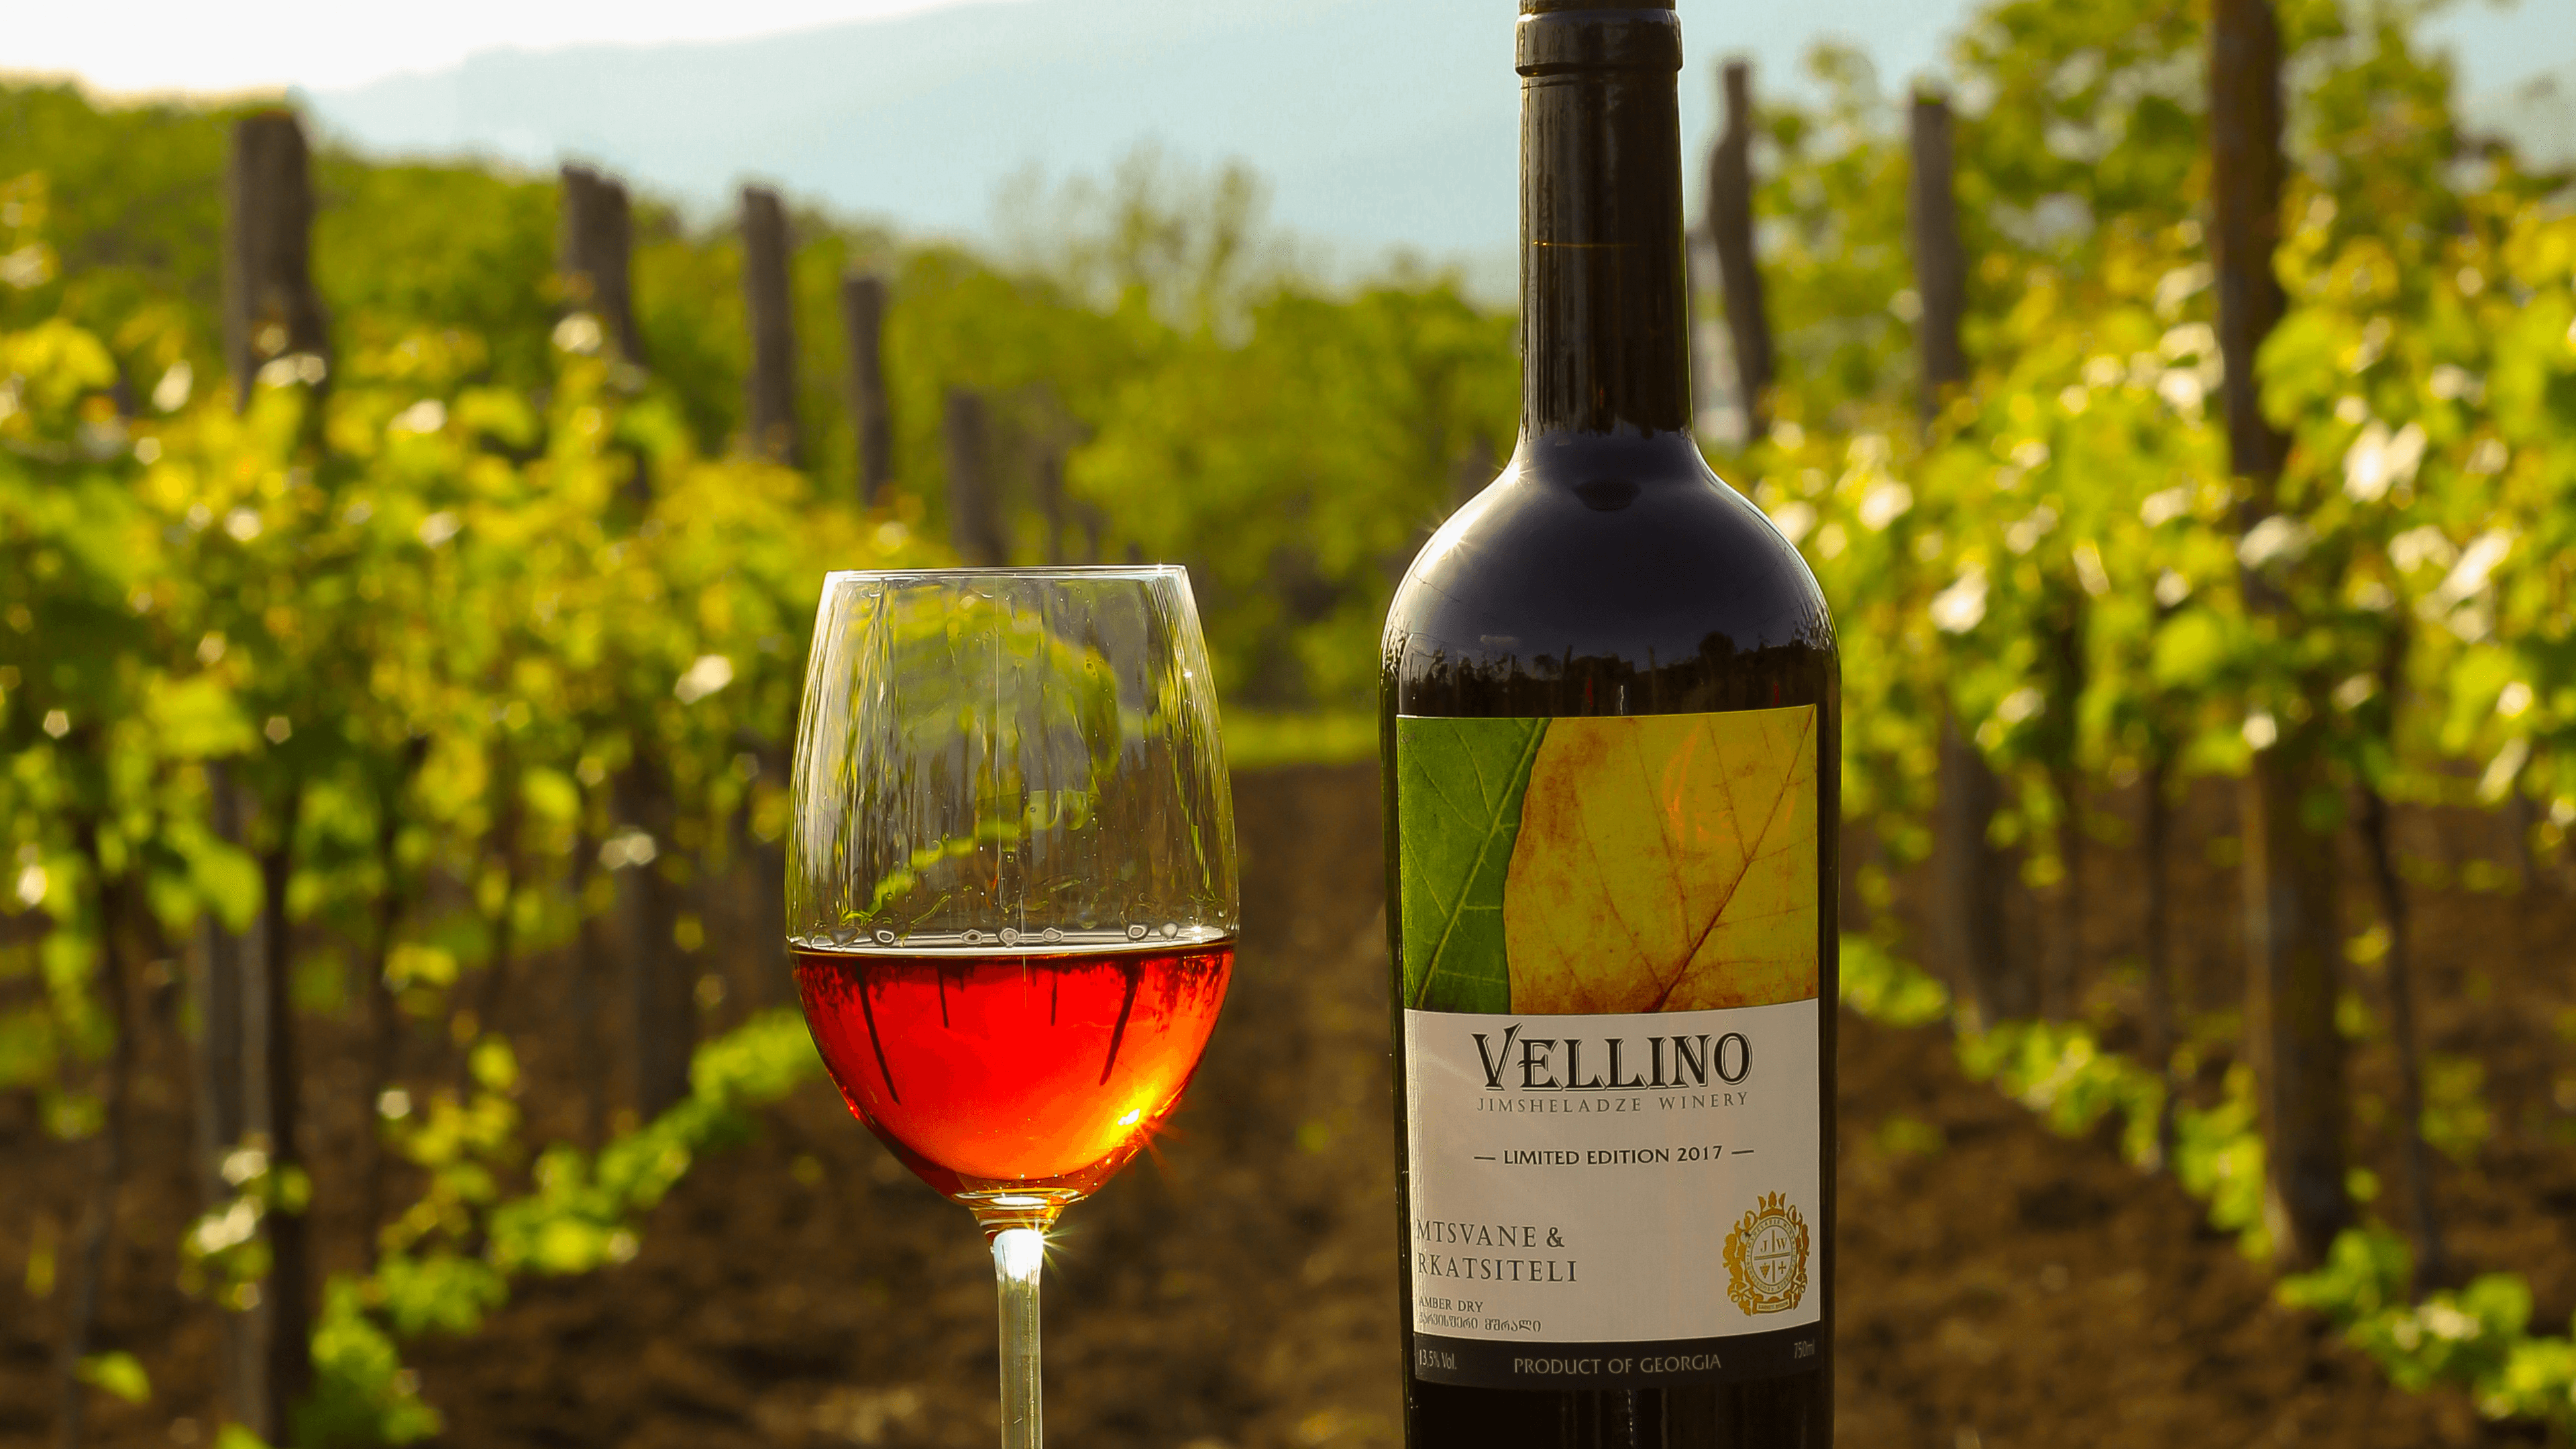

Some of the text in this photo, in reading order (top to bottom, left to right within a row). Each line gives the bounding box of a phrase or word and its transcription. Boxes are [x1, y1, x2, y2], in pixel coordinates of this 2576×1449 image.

[1470, 1022, 1753, 1091] VELLINO
[1477, 1091, 1749, 1114] JIMSHELADZE WINERY
[1503, 1145, 1723, 1166] LIMITED EDITION 2017
[1416, 1219, 1565, 1248] MTSVANE &
[1418, 1252, 1577, 1283] RKATSITELI
[1418, 1295, 1484, 1313] AMBER DRY
[1793, 1338, 1815, 1359] 750ml
[1514, 1354, 1721, 1375] PRODUCT OF GEORGIA
